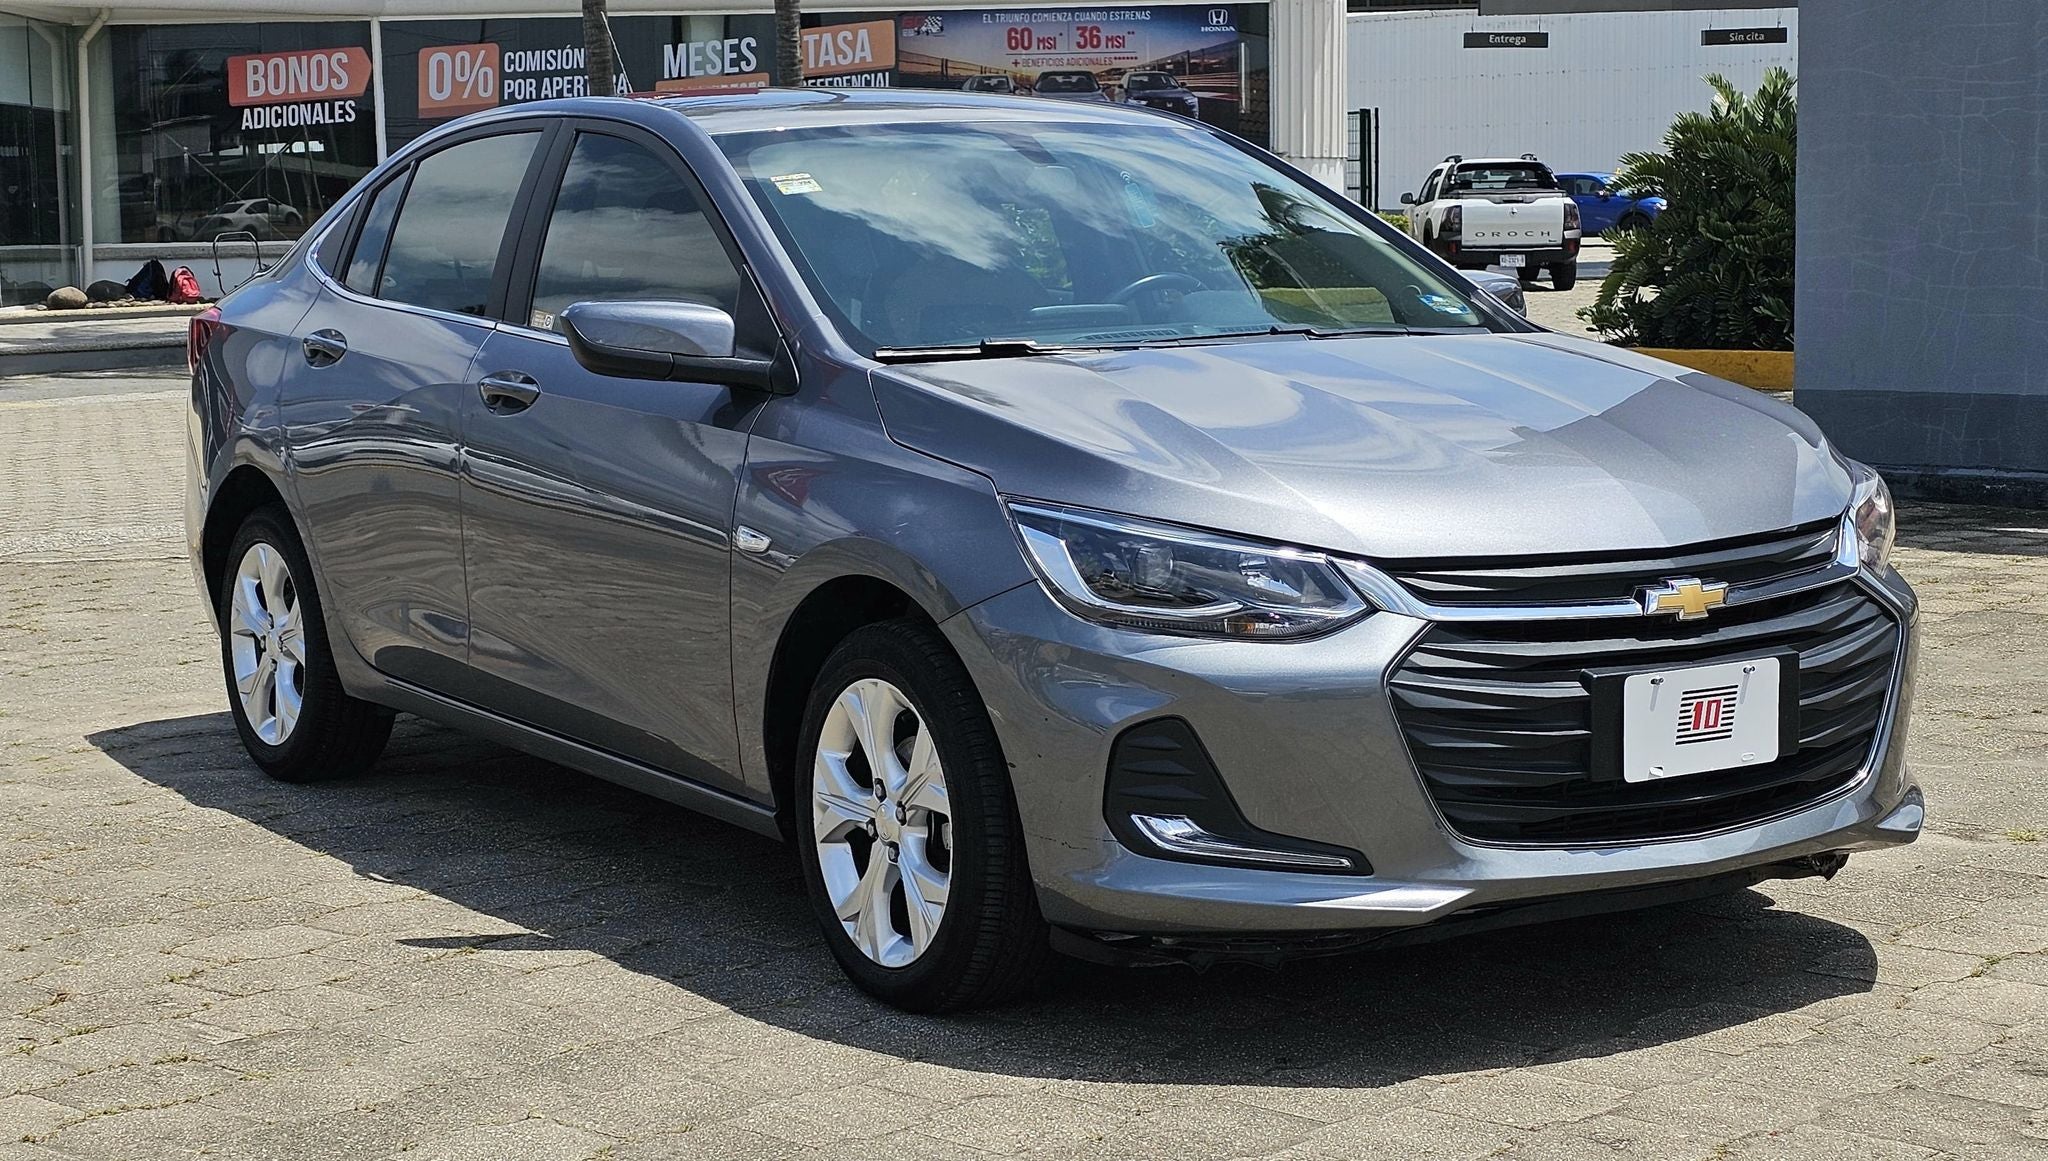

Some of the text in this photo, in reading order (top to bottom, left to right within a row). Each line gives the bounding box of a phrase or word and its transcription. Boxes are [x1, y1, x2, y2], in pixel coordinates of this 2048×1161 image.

[983, 10, 1151, 24] EL TRIUNFO COMIENZA CUANDO ESTRENAS
[803, 28, 873, 69] TASA
[1007, 26, 1033, 50] 60
[1076, 25, 1102, 49] 36
[1488, 34, 1527, 46] Entrega
[1729, 31, 1765, 42] Sin cita
[504, 44, 585, 73] COMISIÓN
[663, 36, 757, 79] MESES
[1022, 57, 1065, 67] BENEFICIOS
[245, 52, 349, 98] BONOS
[428, 49, 494, 101] 0%
[504, 72, 628, 100] POR APERTA
[241, 99, 356, 131] ADICIONALES
[1474, 230, 1551, 238] OROCH
[1692, 699, 1722, 730] 10
